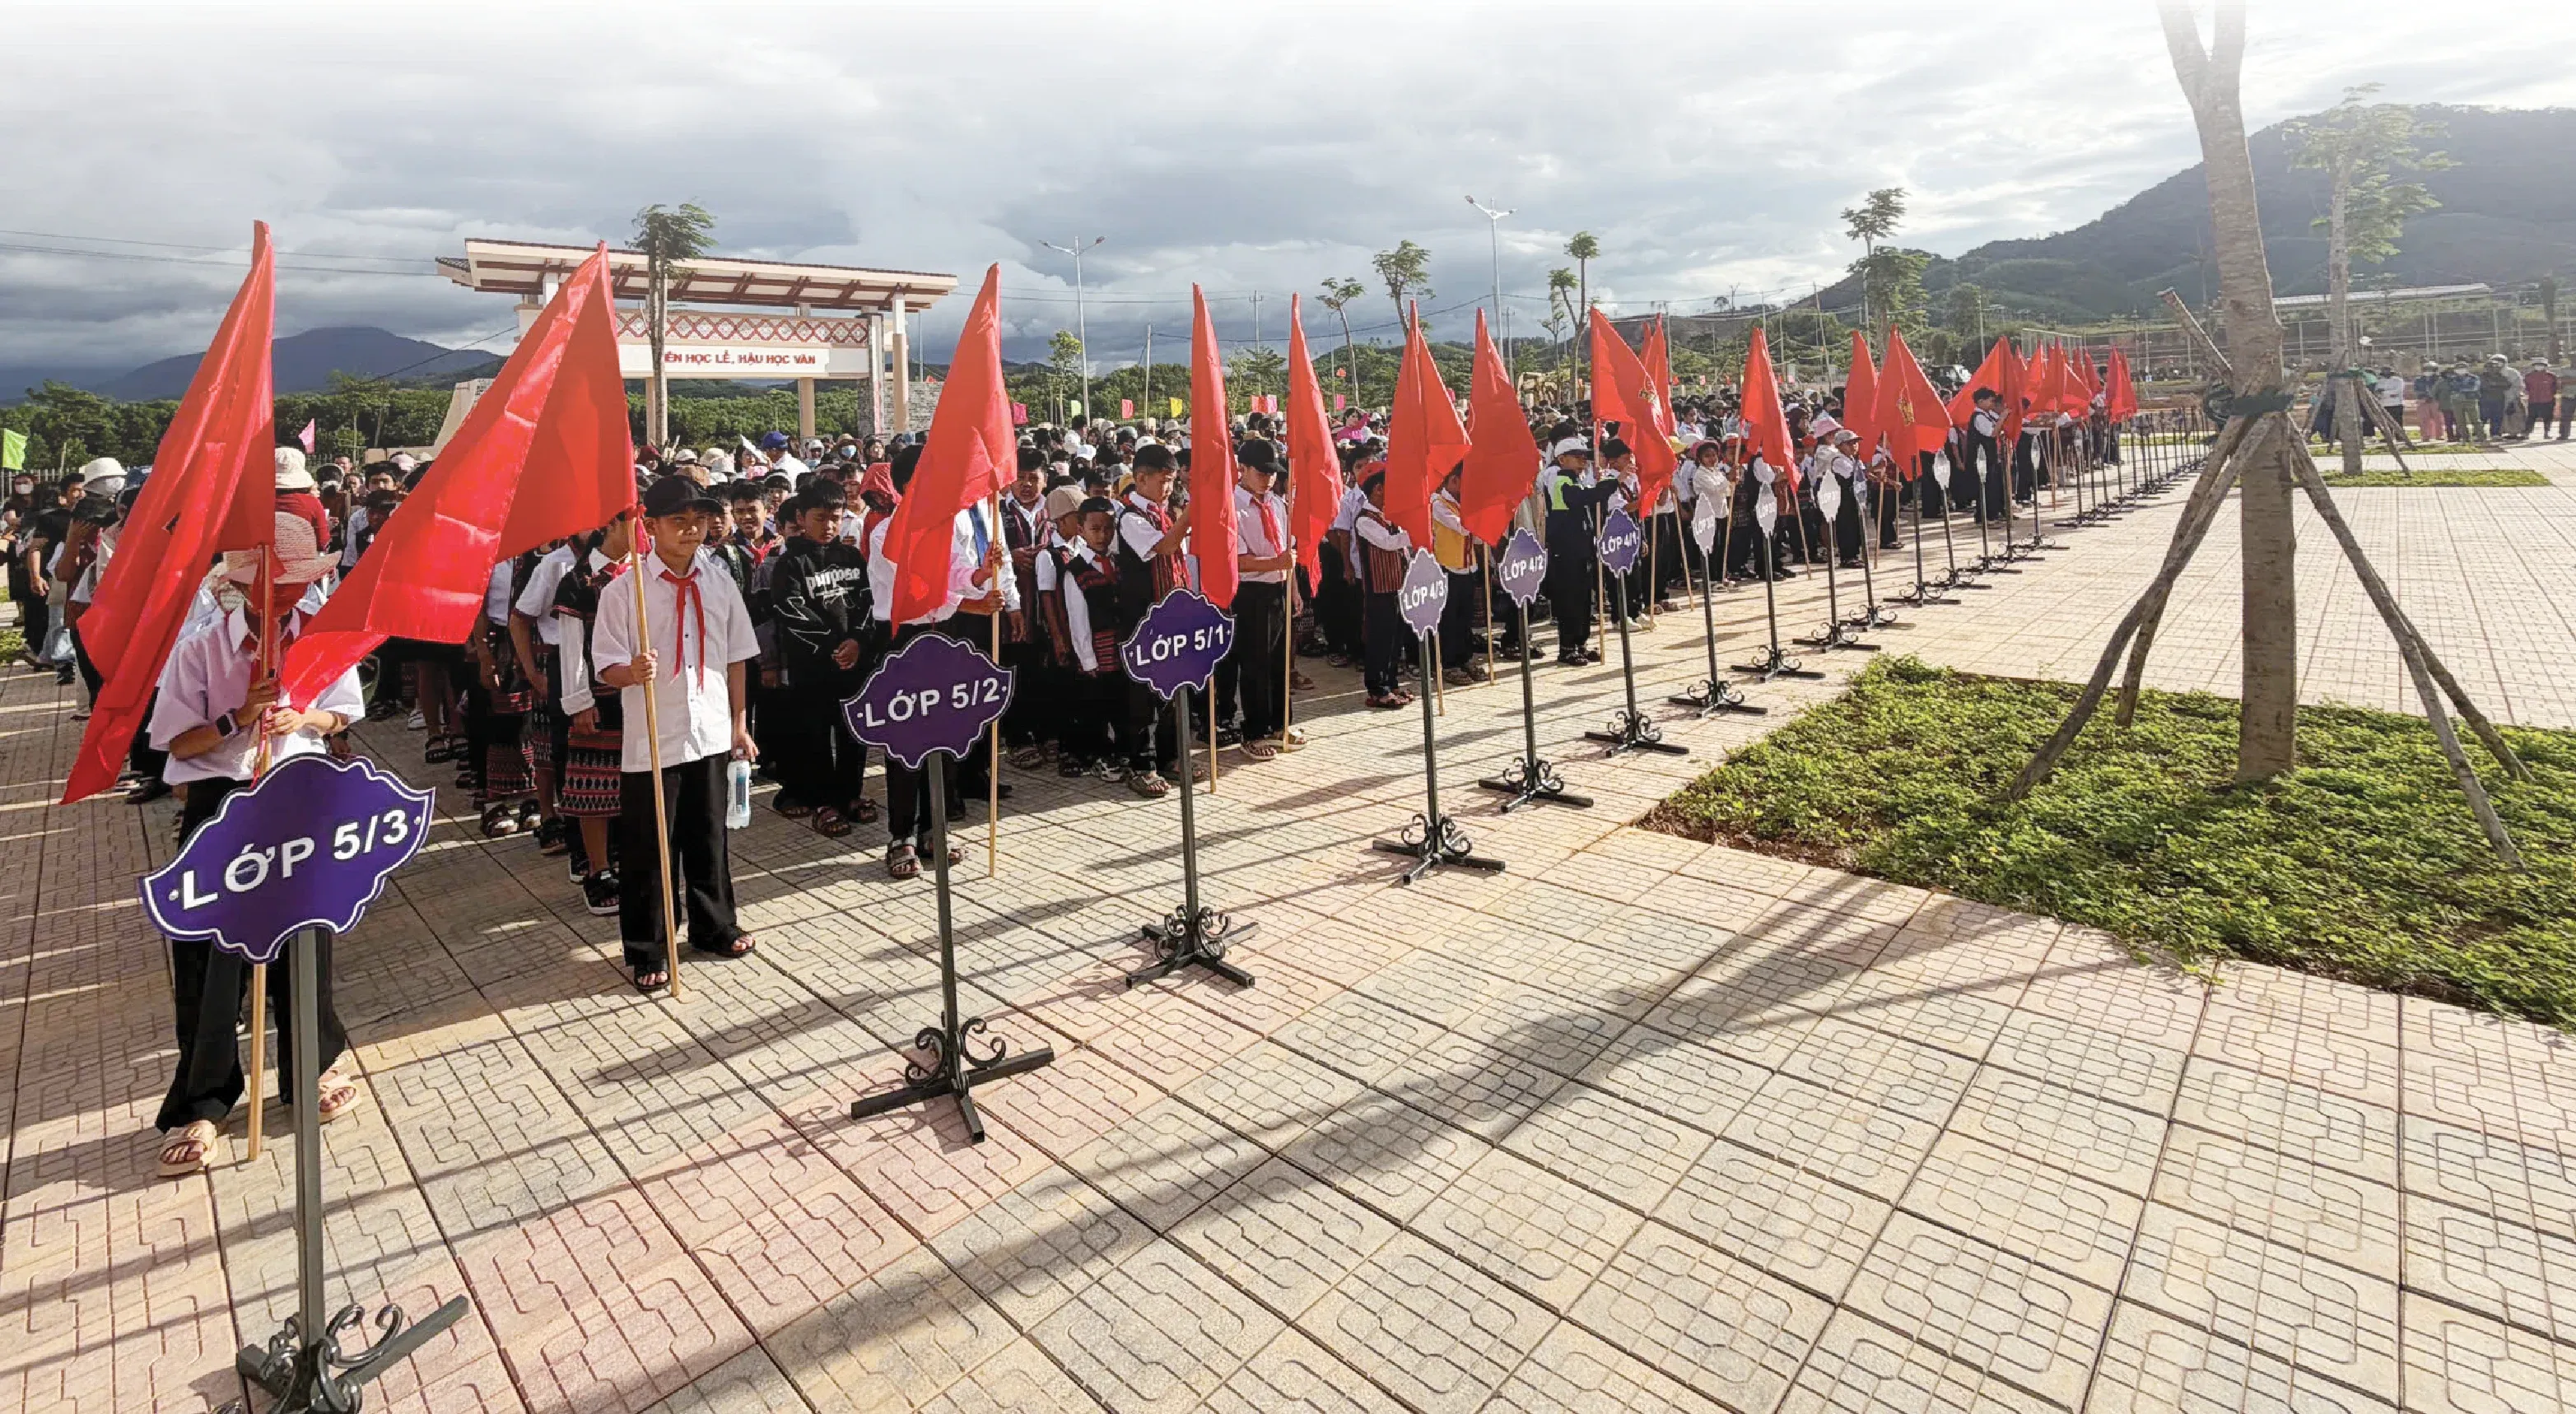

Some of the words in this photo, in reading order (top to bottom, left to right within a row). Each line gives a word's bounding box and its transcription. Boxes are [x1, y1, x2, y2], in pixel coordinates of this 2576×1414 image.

[664, 351, 682, 364] IÊN
[685, 354, 711, 365] HỌC
[739, 352, 763, 365] HẬU
[766, 355, 790, 366] HỌC
[1602, 536, 1623, 555] LỚP
[1505, 559, 1527, 581] LỚP
[1530, 555, 1544, 572] 4/2
[1404, 585, 1428, 611] LỚP
[1430, 580, 1444, 599] 4/3
[1137, 635, 1187, 666] LỚP
[1195, 624, 1224, 650] 5/1
[865, 689, 940, 728] LỚP
[952, 677, 999, 709] 5/2
[182, 836, 314, 910] LỚP
[333, 809, 408, 861] 5/3
